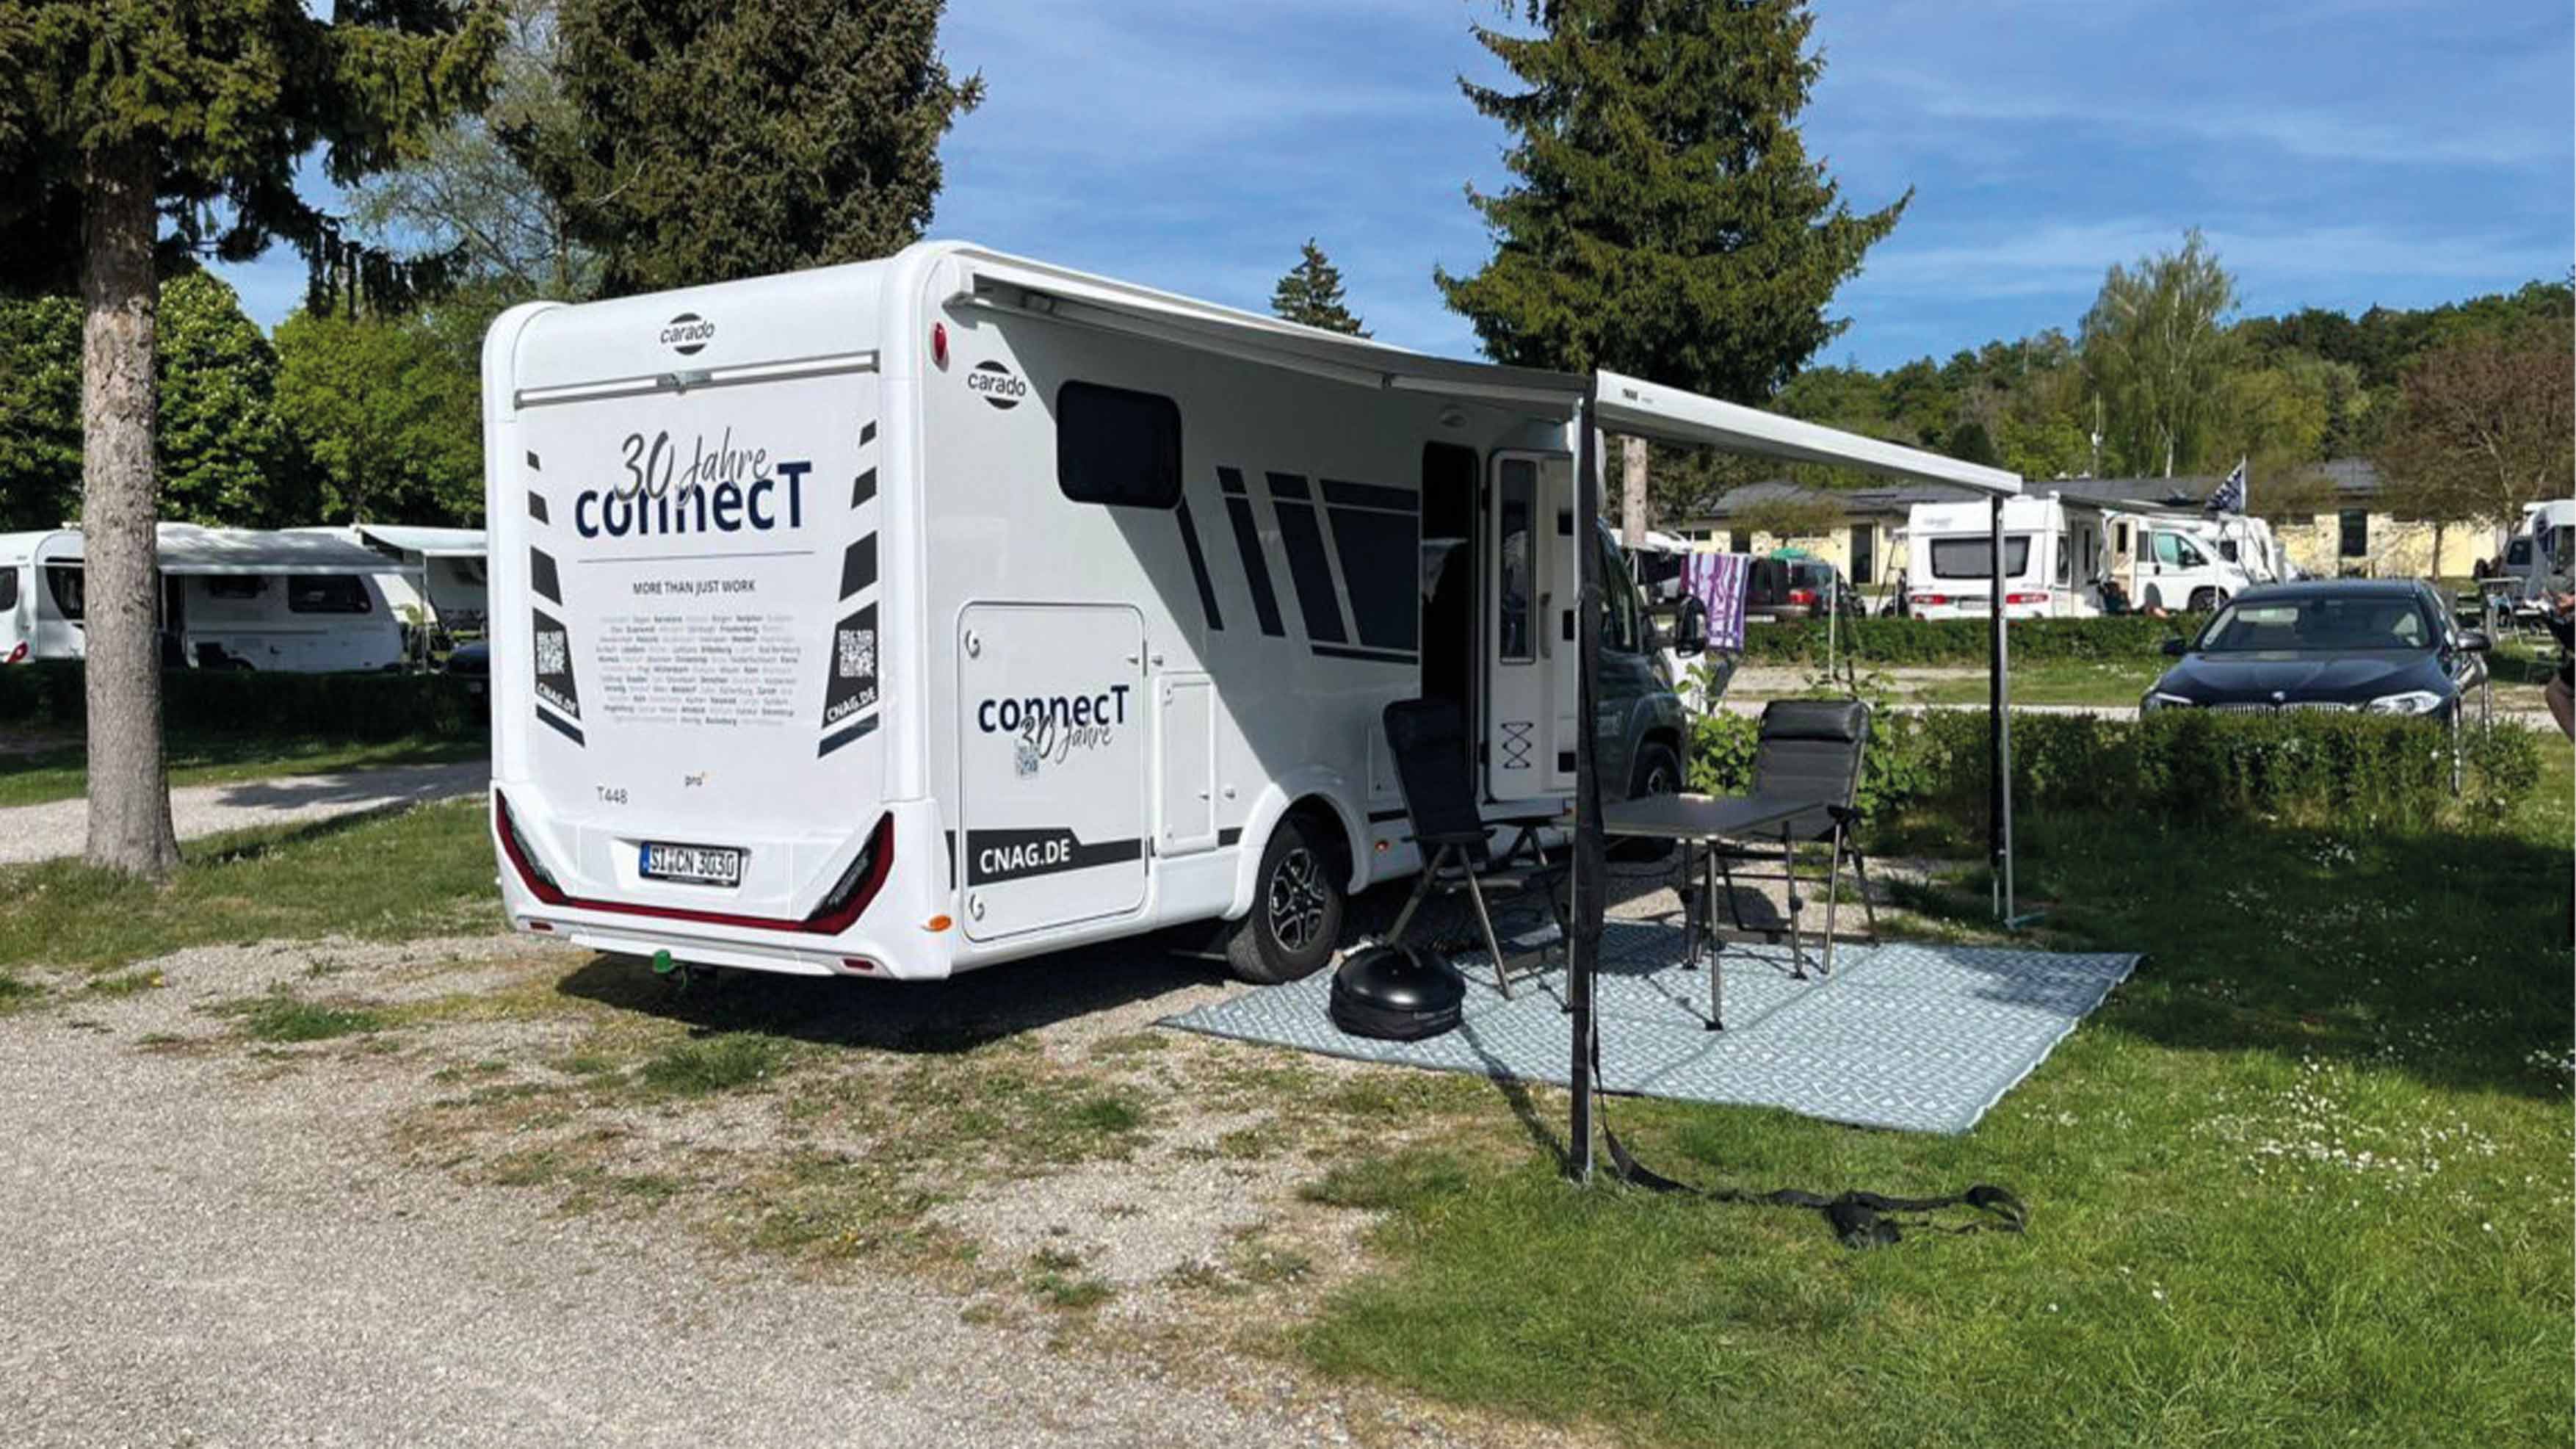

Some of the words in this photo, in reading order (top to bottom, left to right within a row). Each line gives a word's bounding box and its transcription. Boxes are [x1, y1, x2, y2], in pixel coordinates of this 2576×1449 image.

[661, 321, 714, 343] carado
[968, 372, 1026, 397] carado
[615, 431, 673, 501] 30
[677, 427, 770, 507] Jahre
[633, 581, 662, 594] MORE
[665, 581, 693, 593] THAN
[695, 579, 719, 596] JUST
[722, 579, 756, 593] WORK
[538, 682, 576, 715] CNAG.DE
[827, 687, 875, 721] CNAG.DE
[596, 786, 628, 804] T448
[698, 851, 734, 876] 3030
[980, 839, 1070, 873] CNAG.DE
